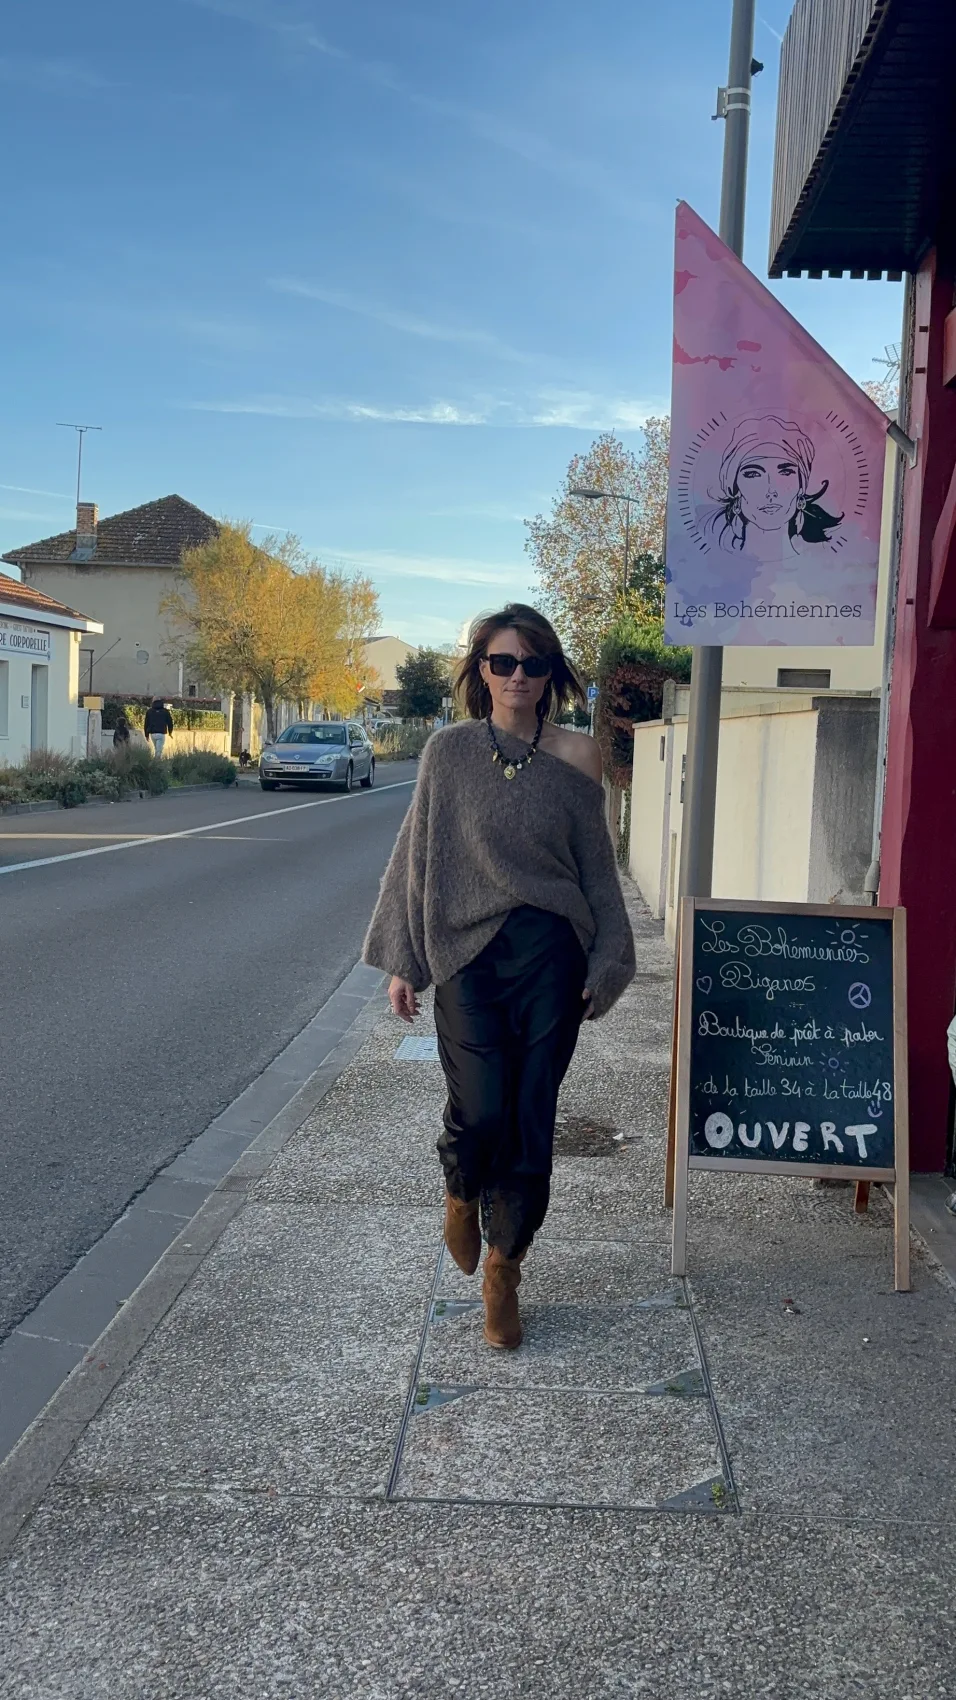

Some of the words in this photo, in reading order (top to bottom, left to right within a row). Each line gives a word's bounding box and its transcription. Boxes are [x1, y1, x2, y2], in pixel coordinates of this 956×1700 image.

[673, 602, 707, 619] Les
[713, 600, 862, 619] Bohémiennes
[10, 634, 47, 651] CORPORELLE
[700, 918, 740, 954] Les
[737, 924, 870, 964] Bohémiennes
[719, 961, 816, 1000] Biganos
[698, 1010, 769, 1046] Boutique
[770, 1022, 786, 1039] de
[790, 1019, 821, 1047] prêt
[824, 1026, 835, 1040] à
[751, 1043, 815, 1067] Féminin
[703, 1077, 719, 1093] de
[722, 1075, 739, 1096] la
[744, 1077, 777, 1097] taille
[780, 1078, 800, 1097] 34
[804, 1081, 816, 1097] à
[704, 1111, 878, 1159] OUVERT
